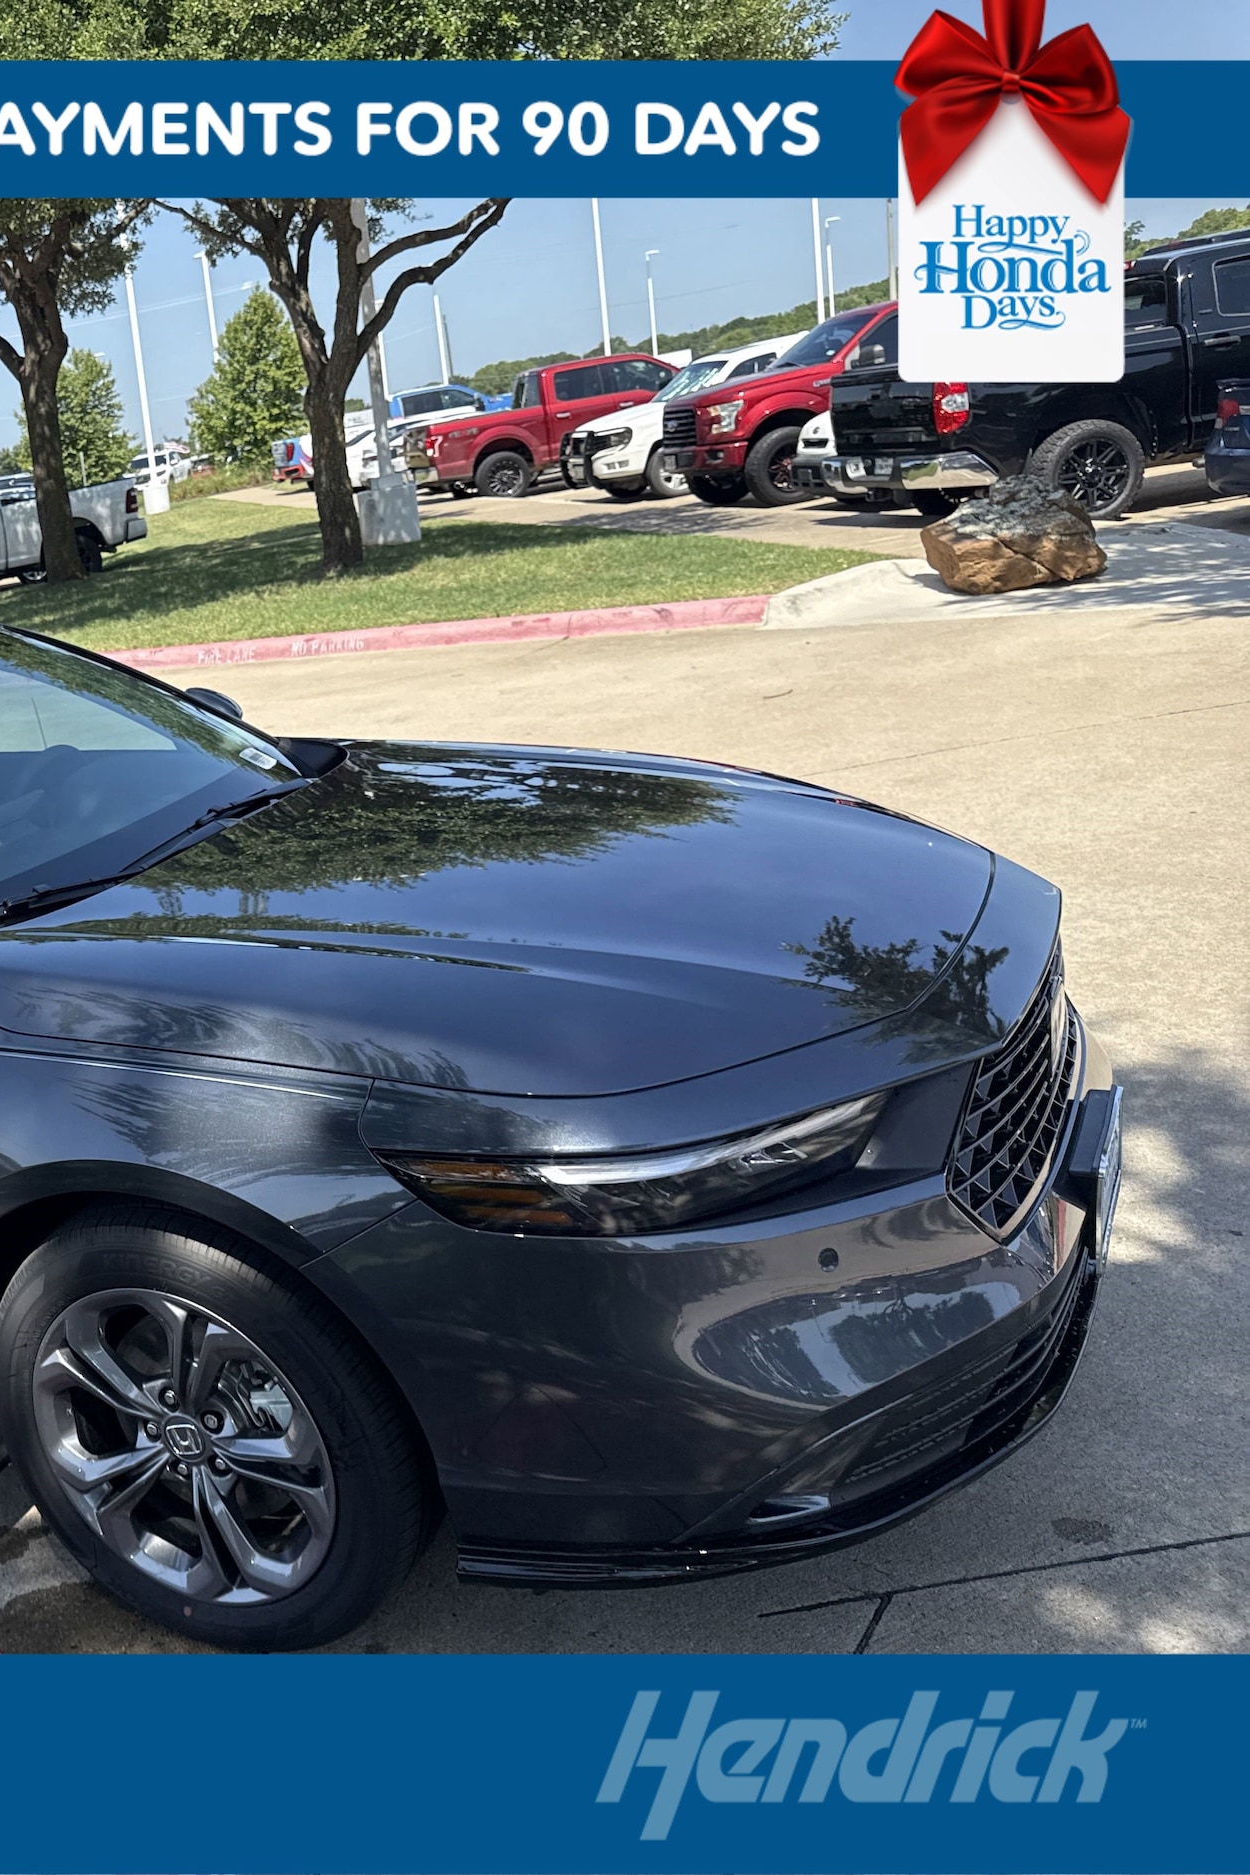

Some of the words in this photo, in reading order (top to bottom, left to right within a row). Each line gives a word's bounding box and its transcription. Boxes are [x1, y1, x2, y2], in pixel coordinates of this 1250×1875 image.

[197, 647, 223, 665] FIRE
[226, 645, 256, 664] LANE
[291, 640, 307, 657] NO
[312, 637, 365, 655] PARKING
